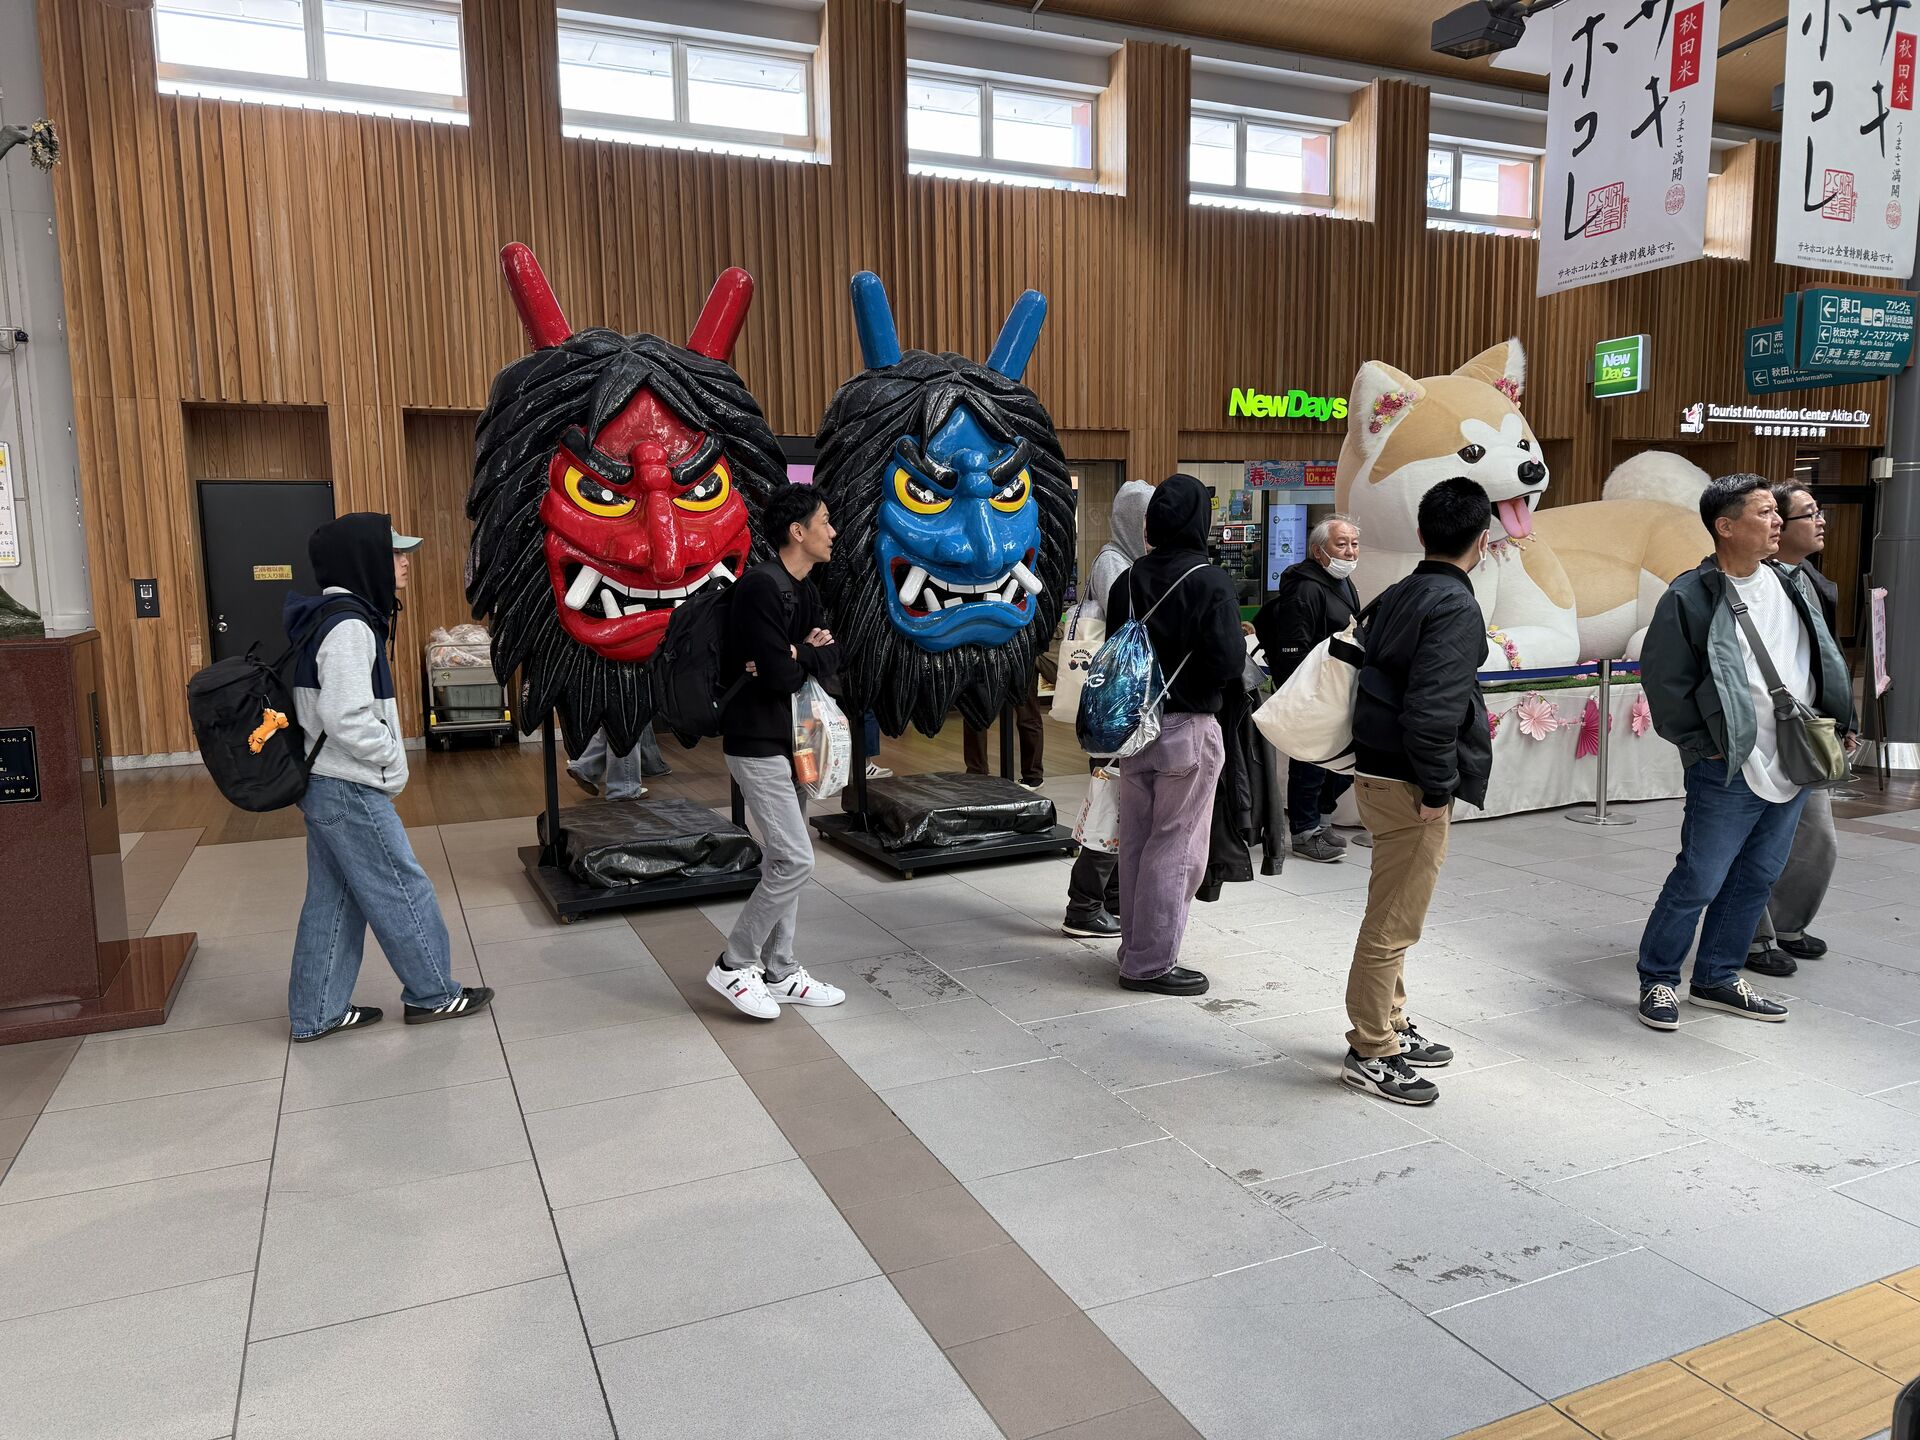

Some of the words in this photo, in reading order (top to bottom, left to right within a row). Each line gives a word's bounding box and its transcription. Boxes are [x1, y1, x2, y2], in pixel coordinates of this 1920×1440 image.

[1677, 12, 1699, 82] 秋田米
[1857, 0, 1912, 159] サキ
[1896, 38, 1913, 104] 秋田米
[1563, 12, 1618, 241] ホコレ
[1672, 100, 1687, 182] うまさ満開
[1891, 121, 1903, 198] うまさ満開
[1557, 241, 1676, 279] サキホコレは全量特別栽培です。
[1798, 241, 1895, 264] サキホコレは全量特別栽培です。
[1840, 298, 1861, 314] 東口
[1886, 300, 1911, 312] アルヴェ
[1602, 367, 1631, 381] Days
[1603, 353, 1630, 367] New
[1773, 376, 1795, 385] Tourist
[1795, 373, 1833, 383] Information
[1228, 387, 1348, 422] NewDays
[1708, 404, 1742, 418] Tourist
[1742, 406, 1799, 420] Information
[1800, 408, 1831, 421] Center
[1831, 409, 1852, 422] Akita
[1853, 410, 1871, 424] City
